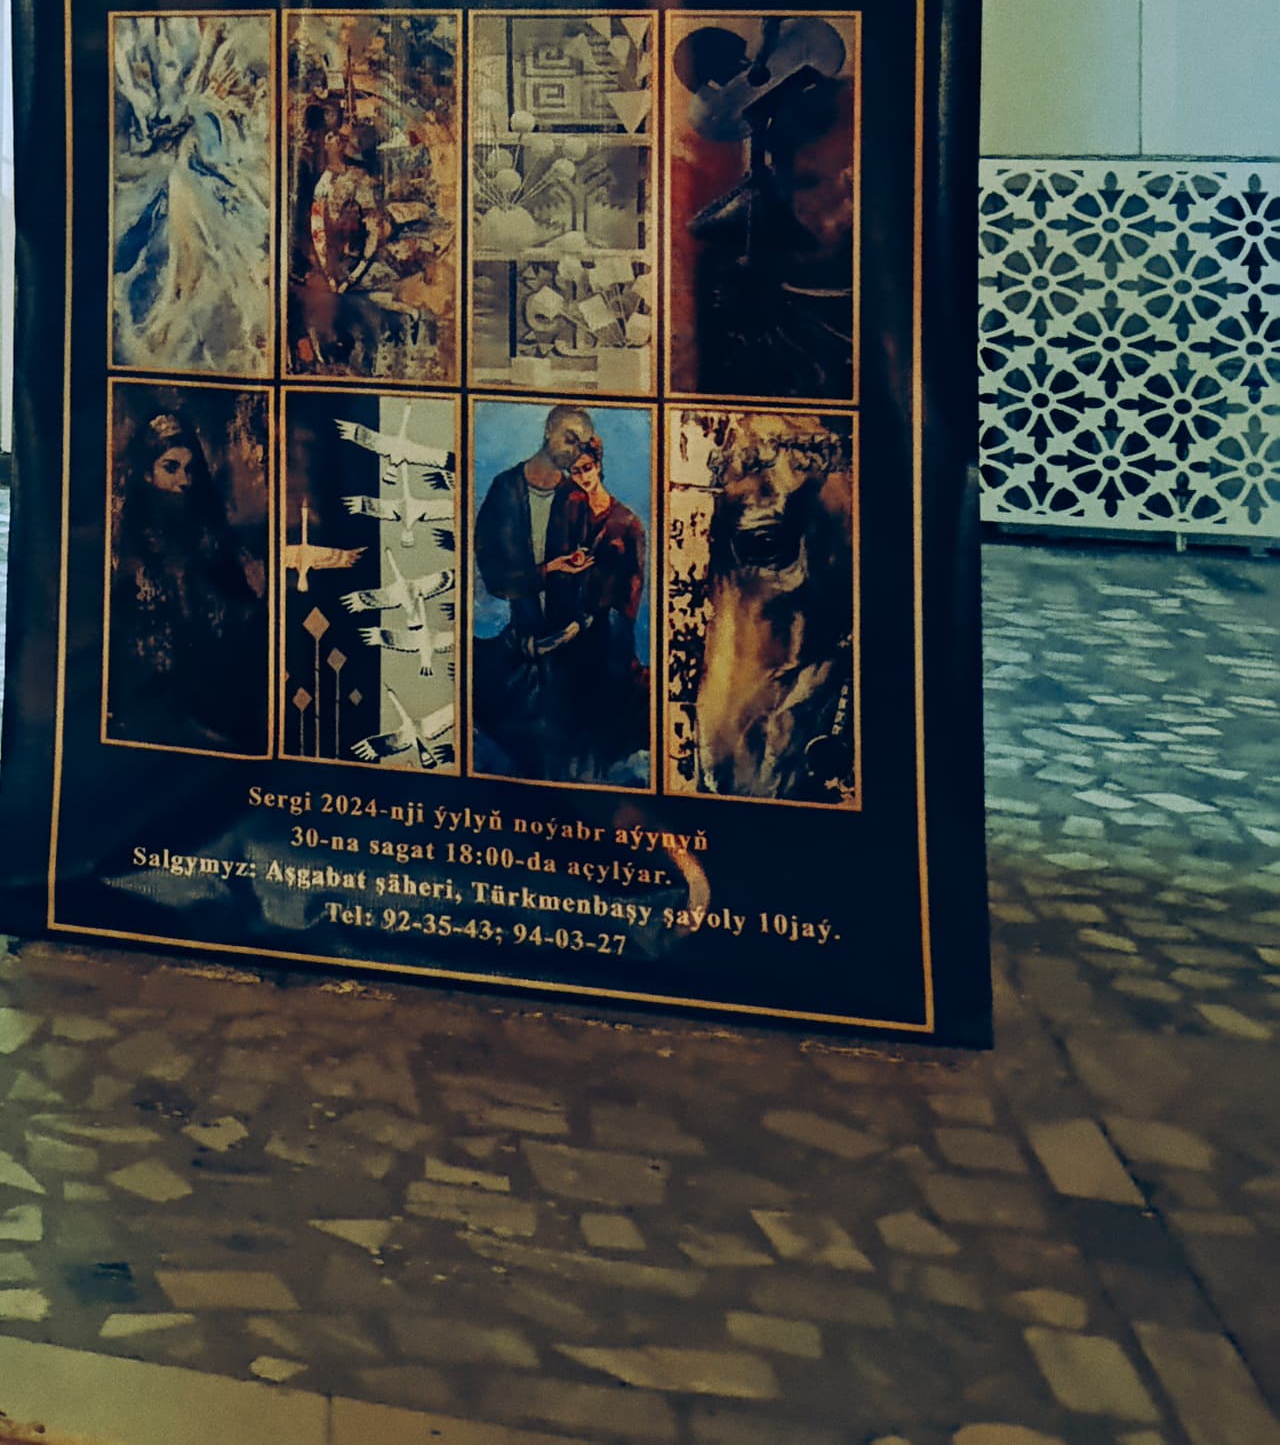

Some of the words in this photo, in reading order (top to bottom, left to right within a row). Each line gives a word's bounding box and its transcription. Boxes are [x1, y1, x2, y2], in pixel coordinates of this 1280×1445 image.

[248, 786, 312, 815] Sergi
[320, 792, 425, 827] 2024-nji
[433, 805, 503, 833] ýylyň
[513, 816, 606, 841] noýabr
[290, 825, 359, 853] 30-na
[369, 839, 436, 864] sagat
[445, 841, 557, 873] 18:00-da
[567, 859, 672, 886] açylýar.
[132, 846, 257, 880] Salgymyz:
[265, 859, 367, 890] Aşgabat
[374, 873, 463, 904] şäheri,
[470, 880, 653, 926] Türkmenbaşy
[324, 902, 374, 927] Tel:
[381, 909, 503, 945] 92-35-43;
[512, 923, 627, 955] 94-03-27
